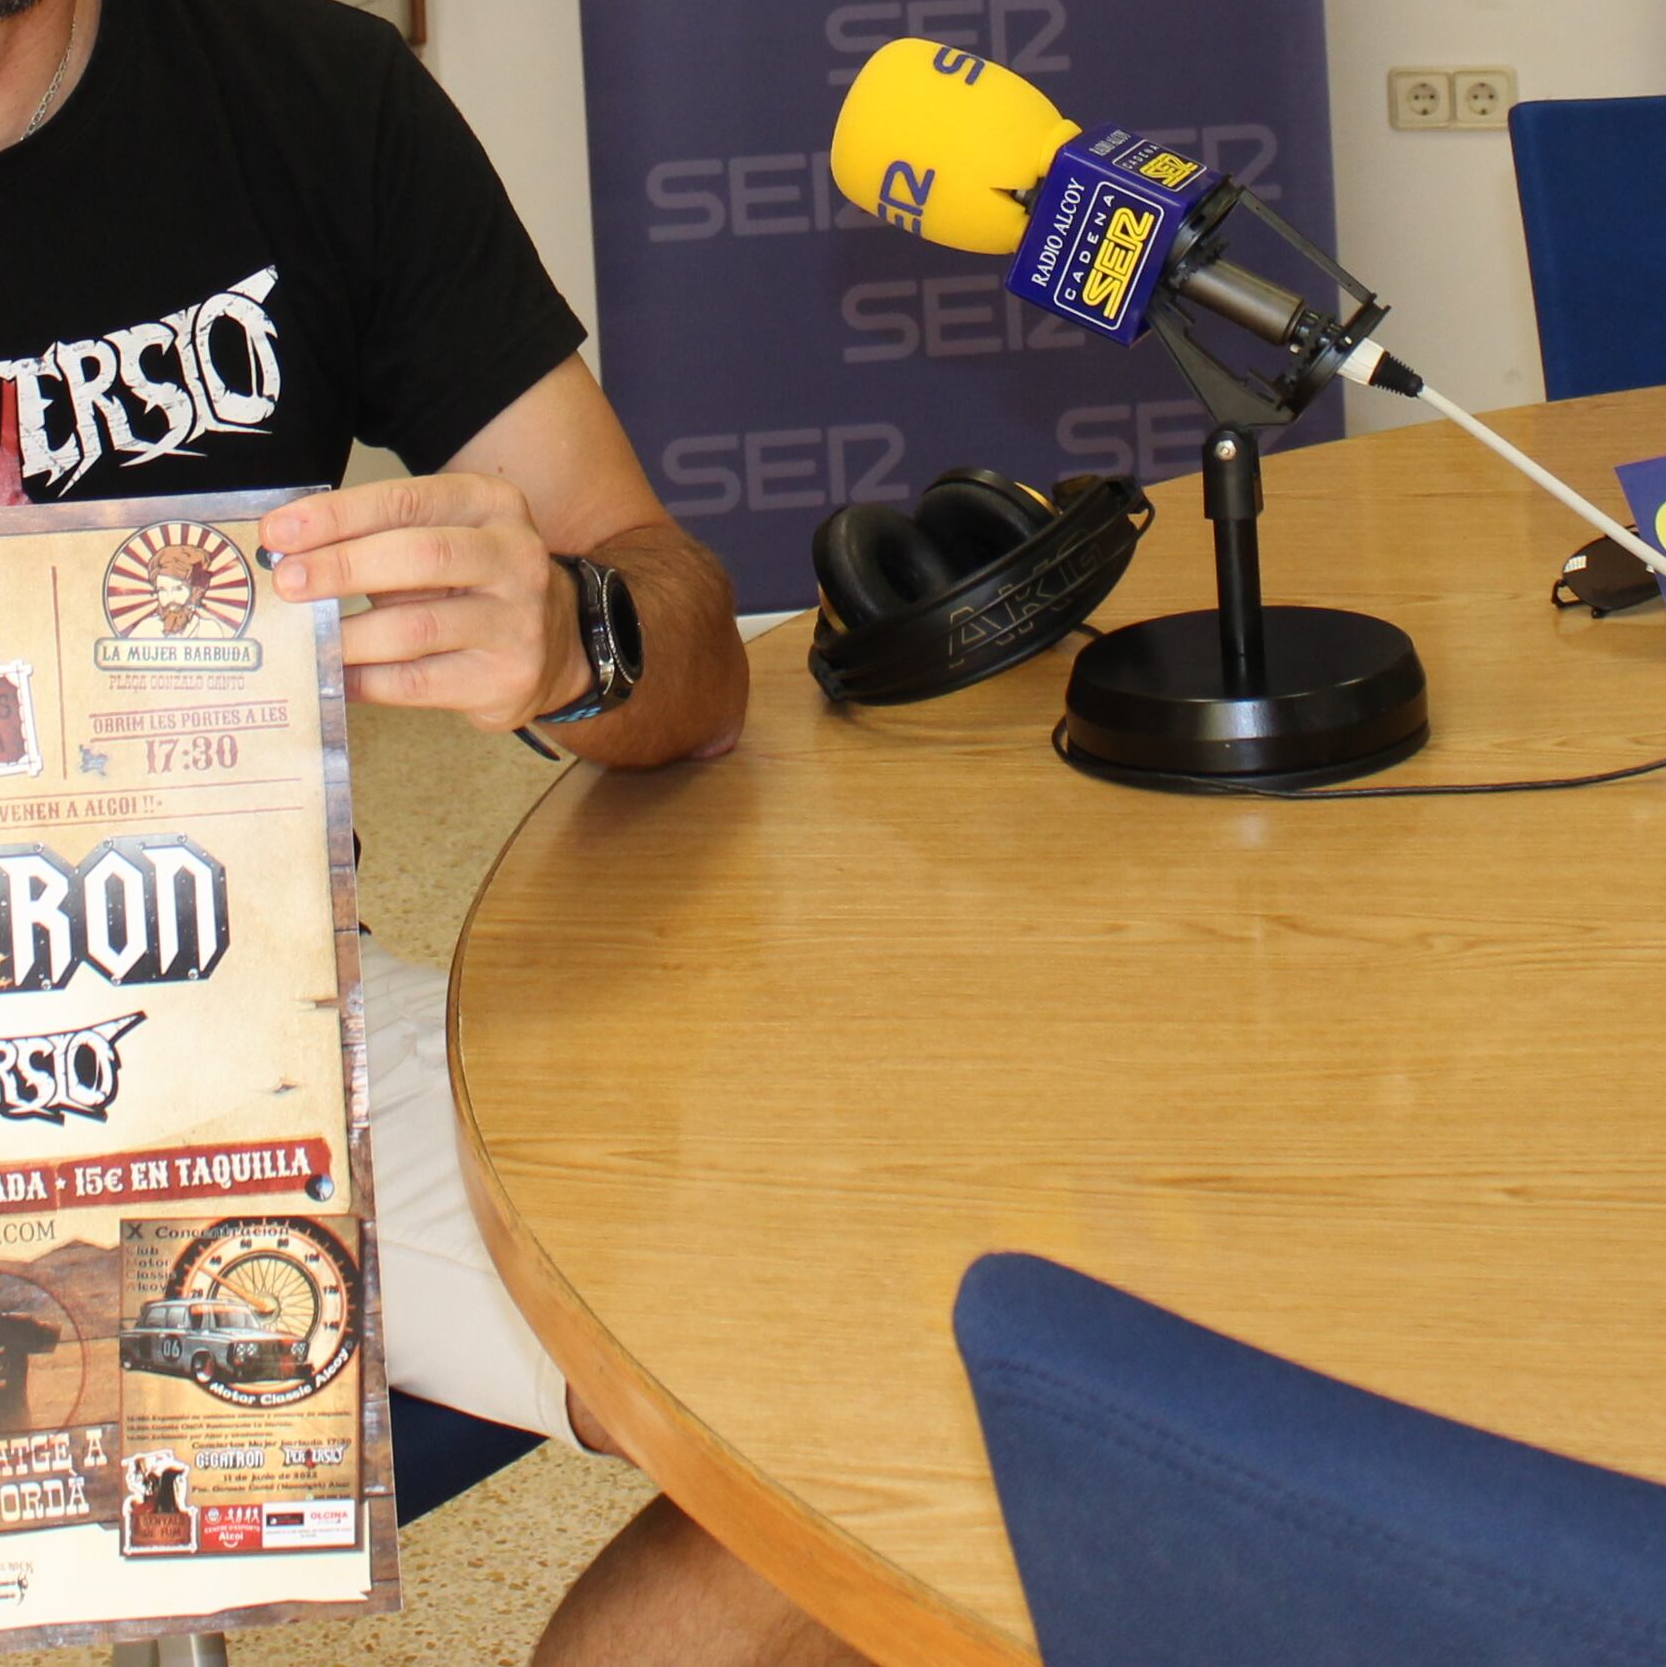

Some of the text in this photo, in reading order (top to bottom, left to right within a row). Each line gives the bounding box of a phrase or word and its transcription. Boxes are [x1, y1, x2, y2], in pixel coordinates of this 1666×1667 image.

[1139, 152, 1198, 188] SER
[1031, 177, 1085, 288] RADIO ALCOY
[1065, 194, 1115, 301] CADENA
[1082, 206, 1155, 320] SER
[662, 422, 910, 518] SER
[102, 646, 252, 662] LA MUJER BARBUDA
[93, 705, 288, 735] OBRIM LES PORTES A LES
[145, 734, 239, 775] 17:30
[66, 798, 80, 819] A
[84, 795, 138, 817] ALCOI
[74, 1165, 123, 1196] 15€
[130, 1160, 170, 1192] EN
[175, 1145, 312, 1189] TAQUILLA
[84, 1428, 108, 1467] A
[218, 1532, 244, 1542] Alcoi
